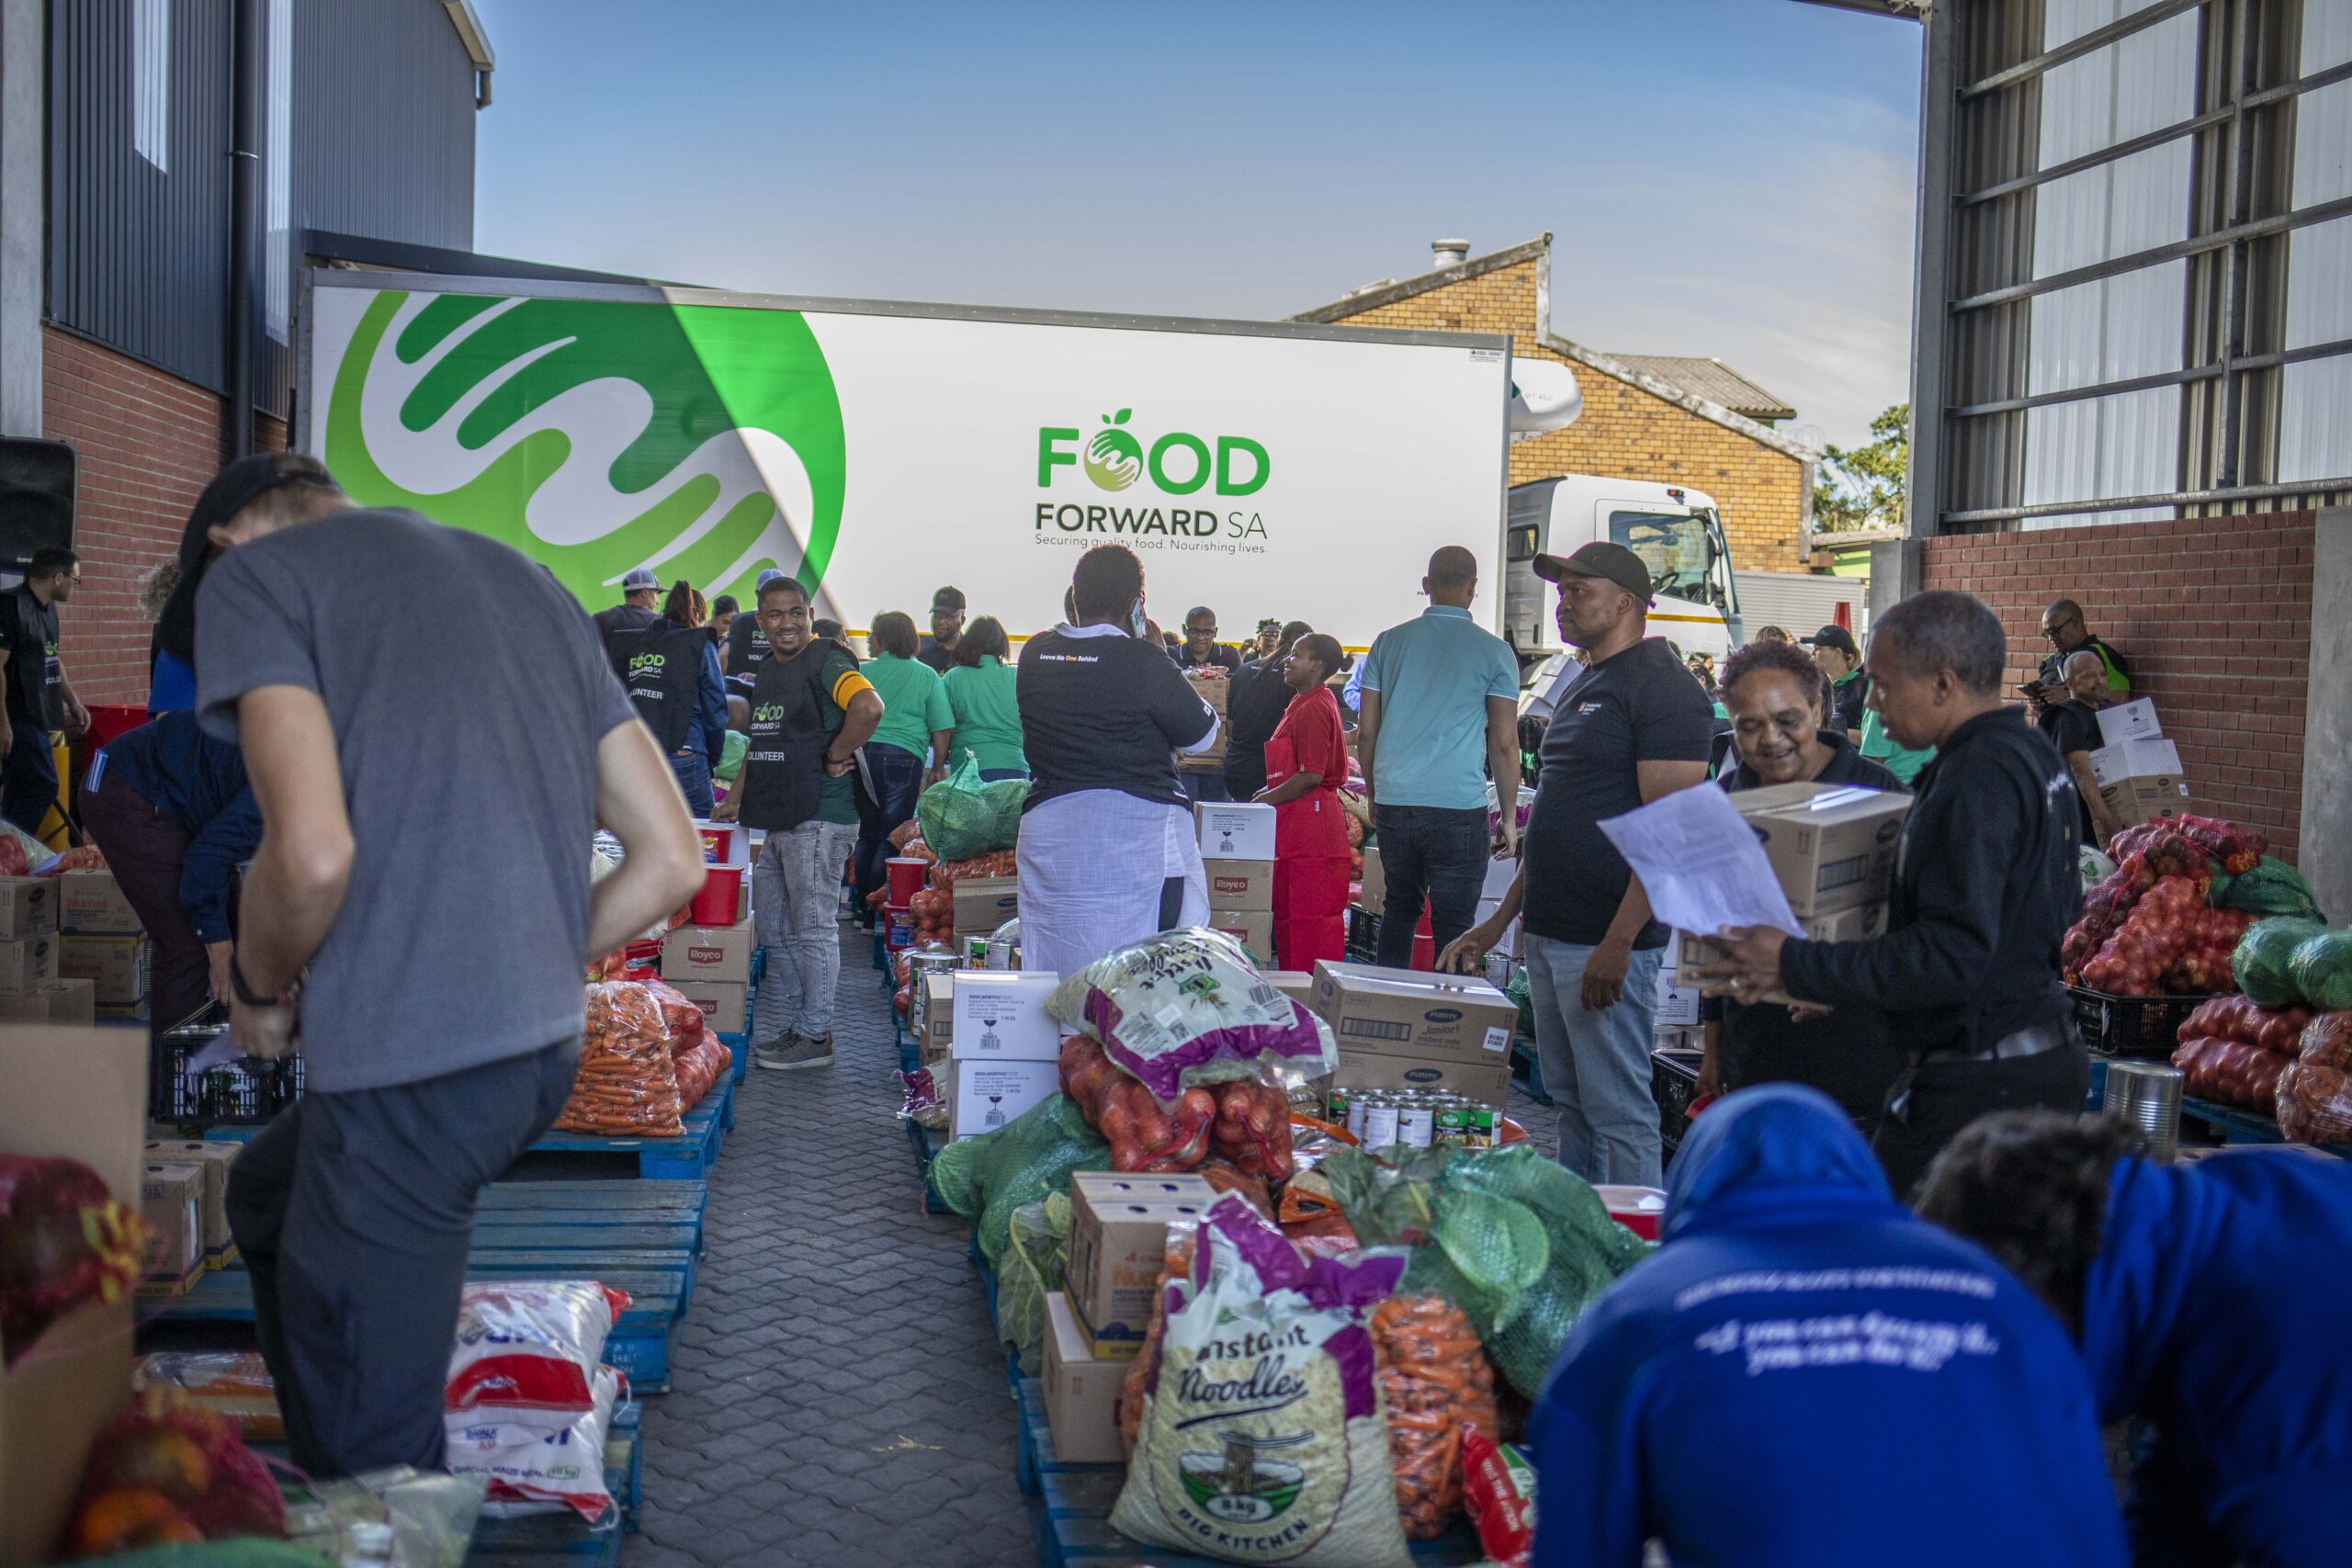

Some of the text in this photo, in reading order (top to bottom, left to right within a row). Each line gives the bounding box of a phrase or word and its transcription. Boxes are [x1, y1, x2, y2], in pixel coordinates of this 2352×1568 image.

[1037, 426, 1271, 496] FOOD
[1035, 502, 1268, 539] FORWARD SA
[1035, 534, 1268, 555] Securing quality food. Nourishing lives.
[629, 653, 665, 670] FOOD
[752, 705, 784, 721] FOOD
[752, 722, 774, 730] ORWARD
[748, 751, 785, 761] OLUNTEER
[1216, 879, 1246, 891] Royco
[690, 950, 721, 961] Royco
[1430, 1011, 1458, 1020] PURITY
[1409, 1071, 1438, 1079] PURITY
[492, 1467, 519, 1476] MAIZE
[521, 1470, 544, 1478] MEAL
[1236, 1499, 1256, 1514] kg
[1178, 1507, 1309, 1551] BIG KITCHEN
